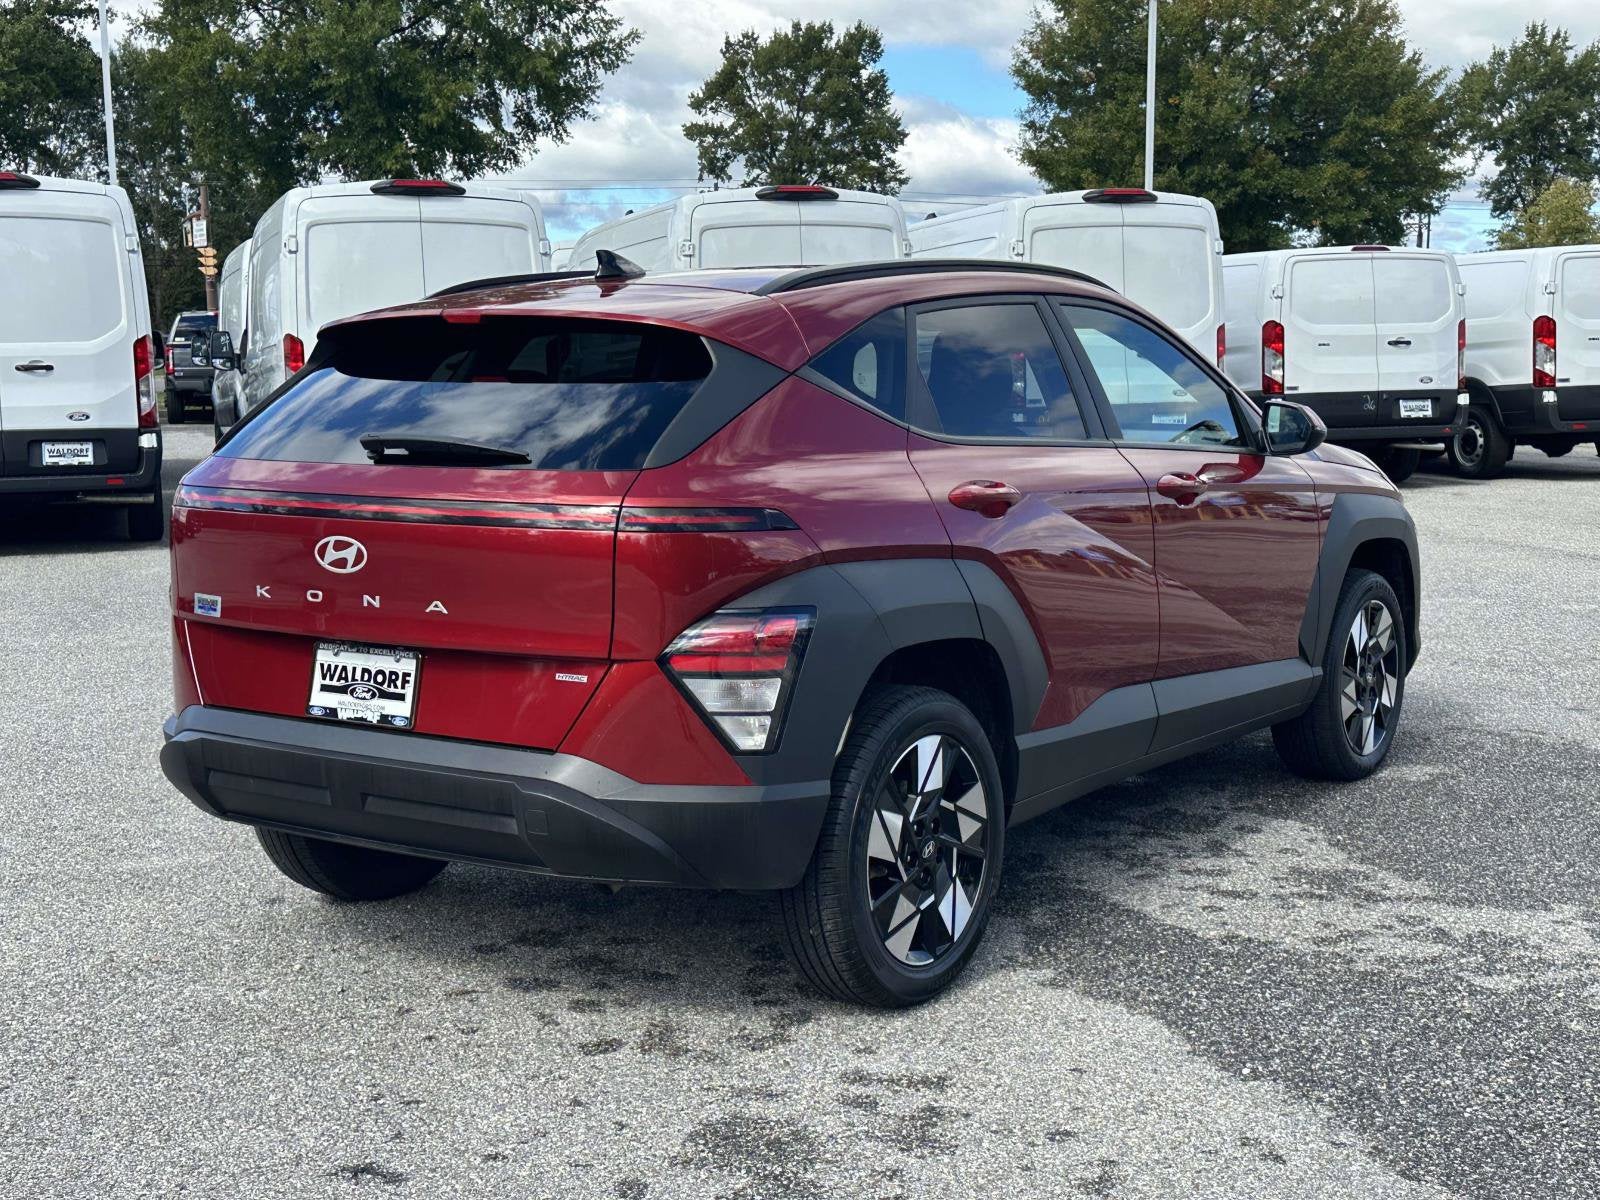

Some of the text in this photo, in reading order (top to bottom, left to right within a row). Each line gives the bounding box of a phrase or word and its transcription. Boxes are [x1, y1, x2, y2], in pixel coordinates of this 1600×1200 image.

[320, 662, 412, 690] WALDORF
[557, 674, 586, 682] HTRAC
[351, 686, 375, 700] Ford
